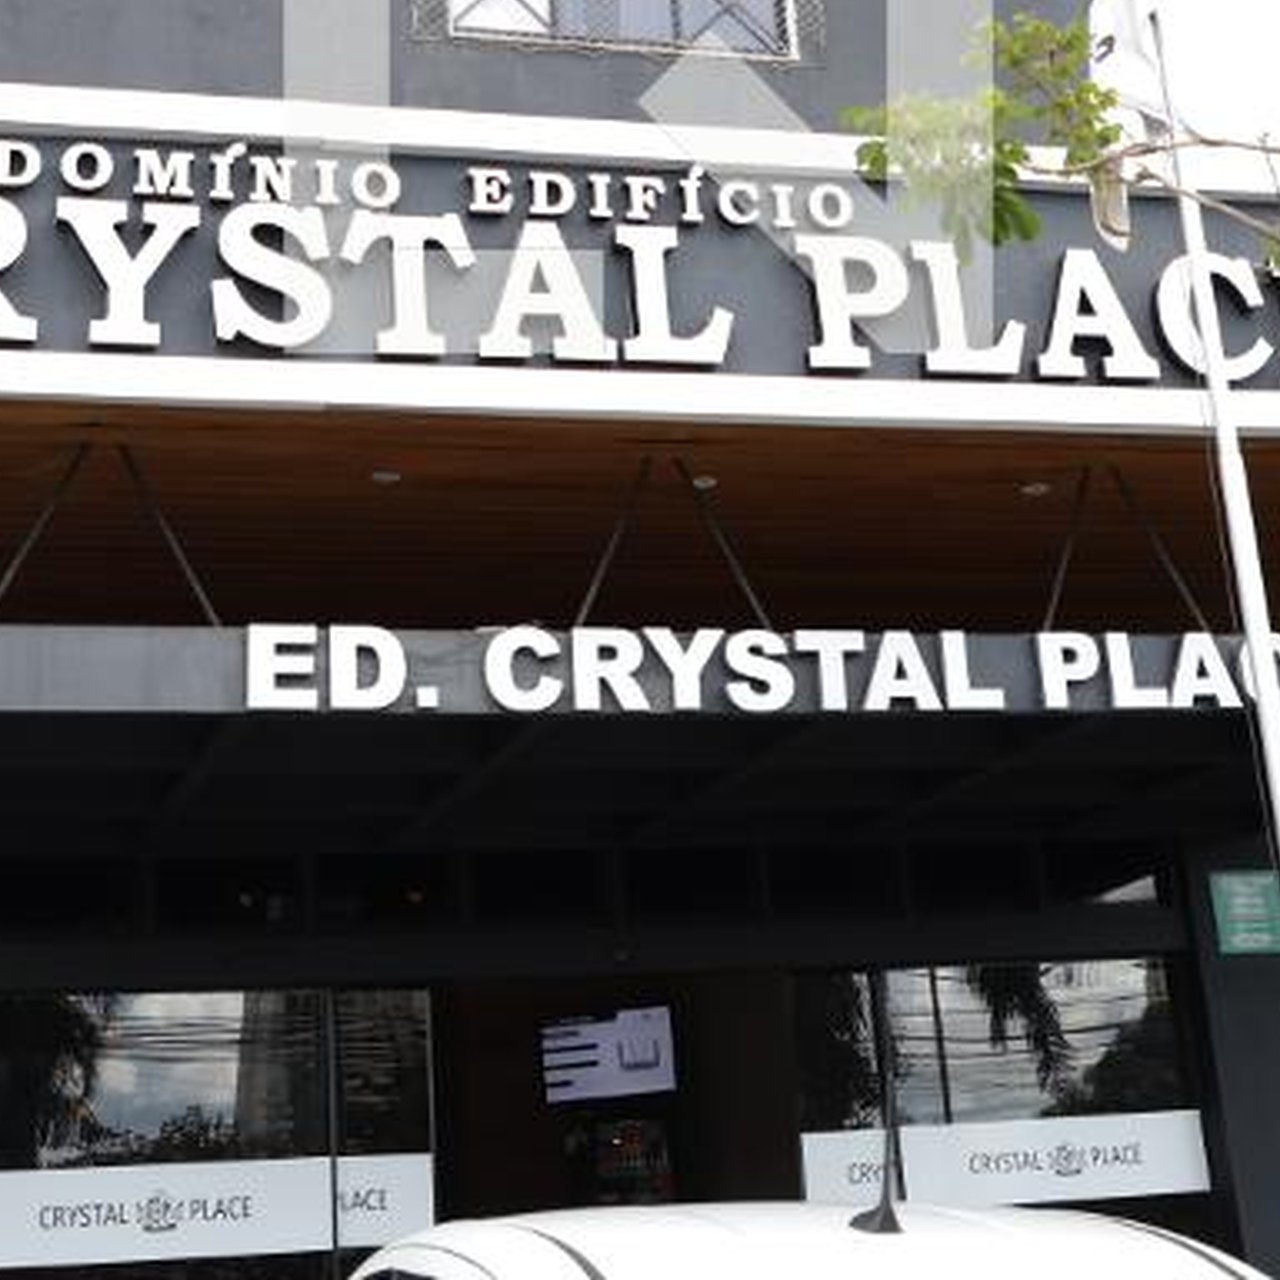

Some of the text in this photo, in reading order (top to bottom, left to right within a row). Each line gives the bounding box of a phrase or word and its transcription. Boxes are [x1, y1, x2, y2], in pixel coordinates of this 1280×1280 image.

[468, 165, 854, 229] EDIFÍCIO
[246, 623, 440, 711] ED.
[483, 625, 1005, 712] CRYSTAL
[38, 1200, 129, 1229] CRYSTAL
[189, 1194, 253, 1221] PLACE
[337, 1187, 388, 1213] LACE
